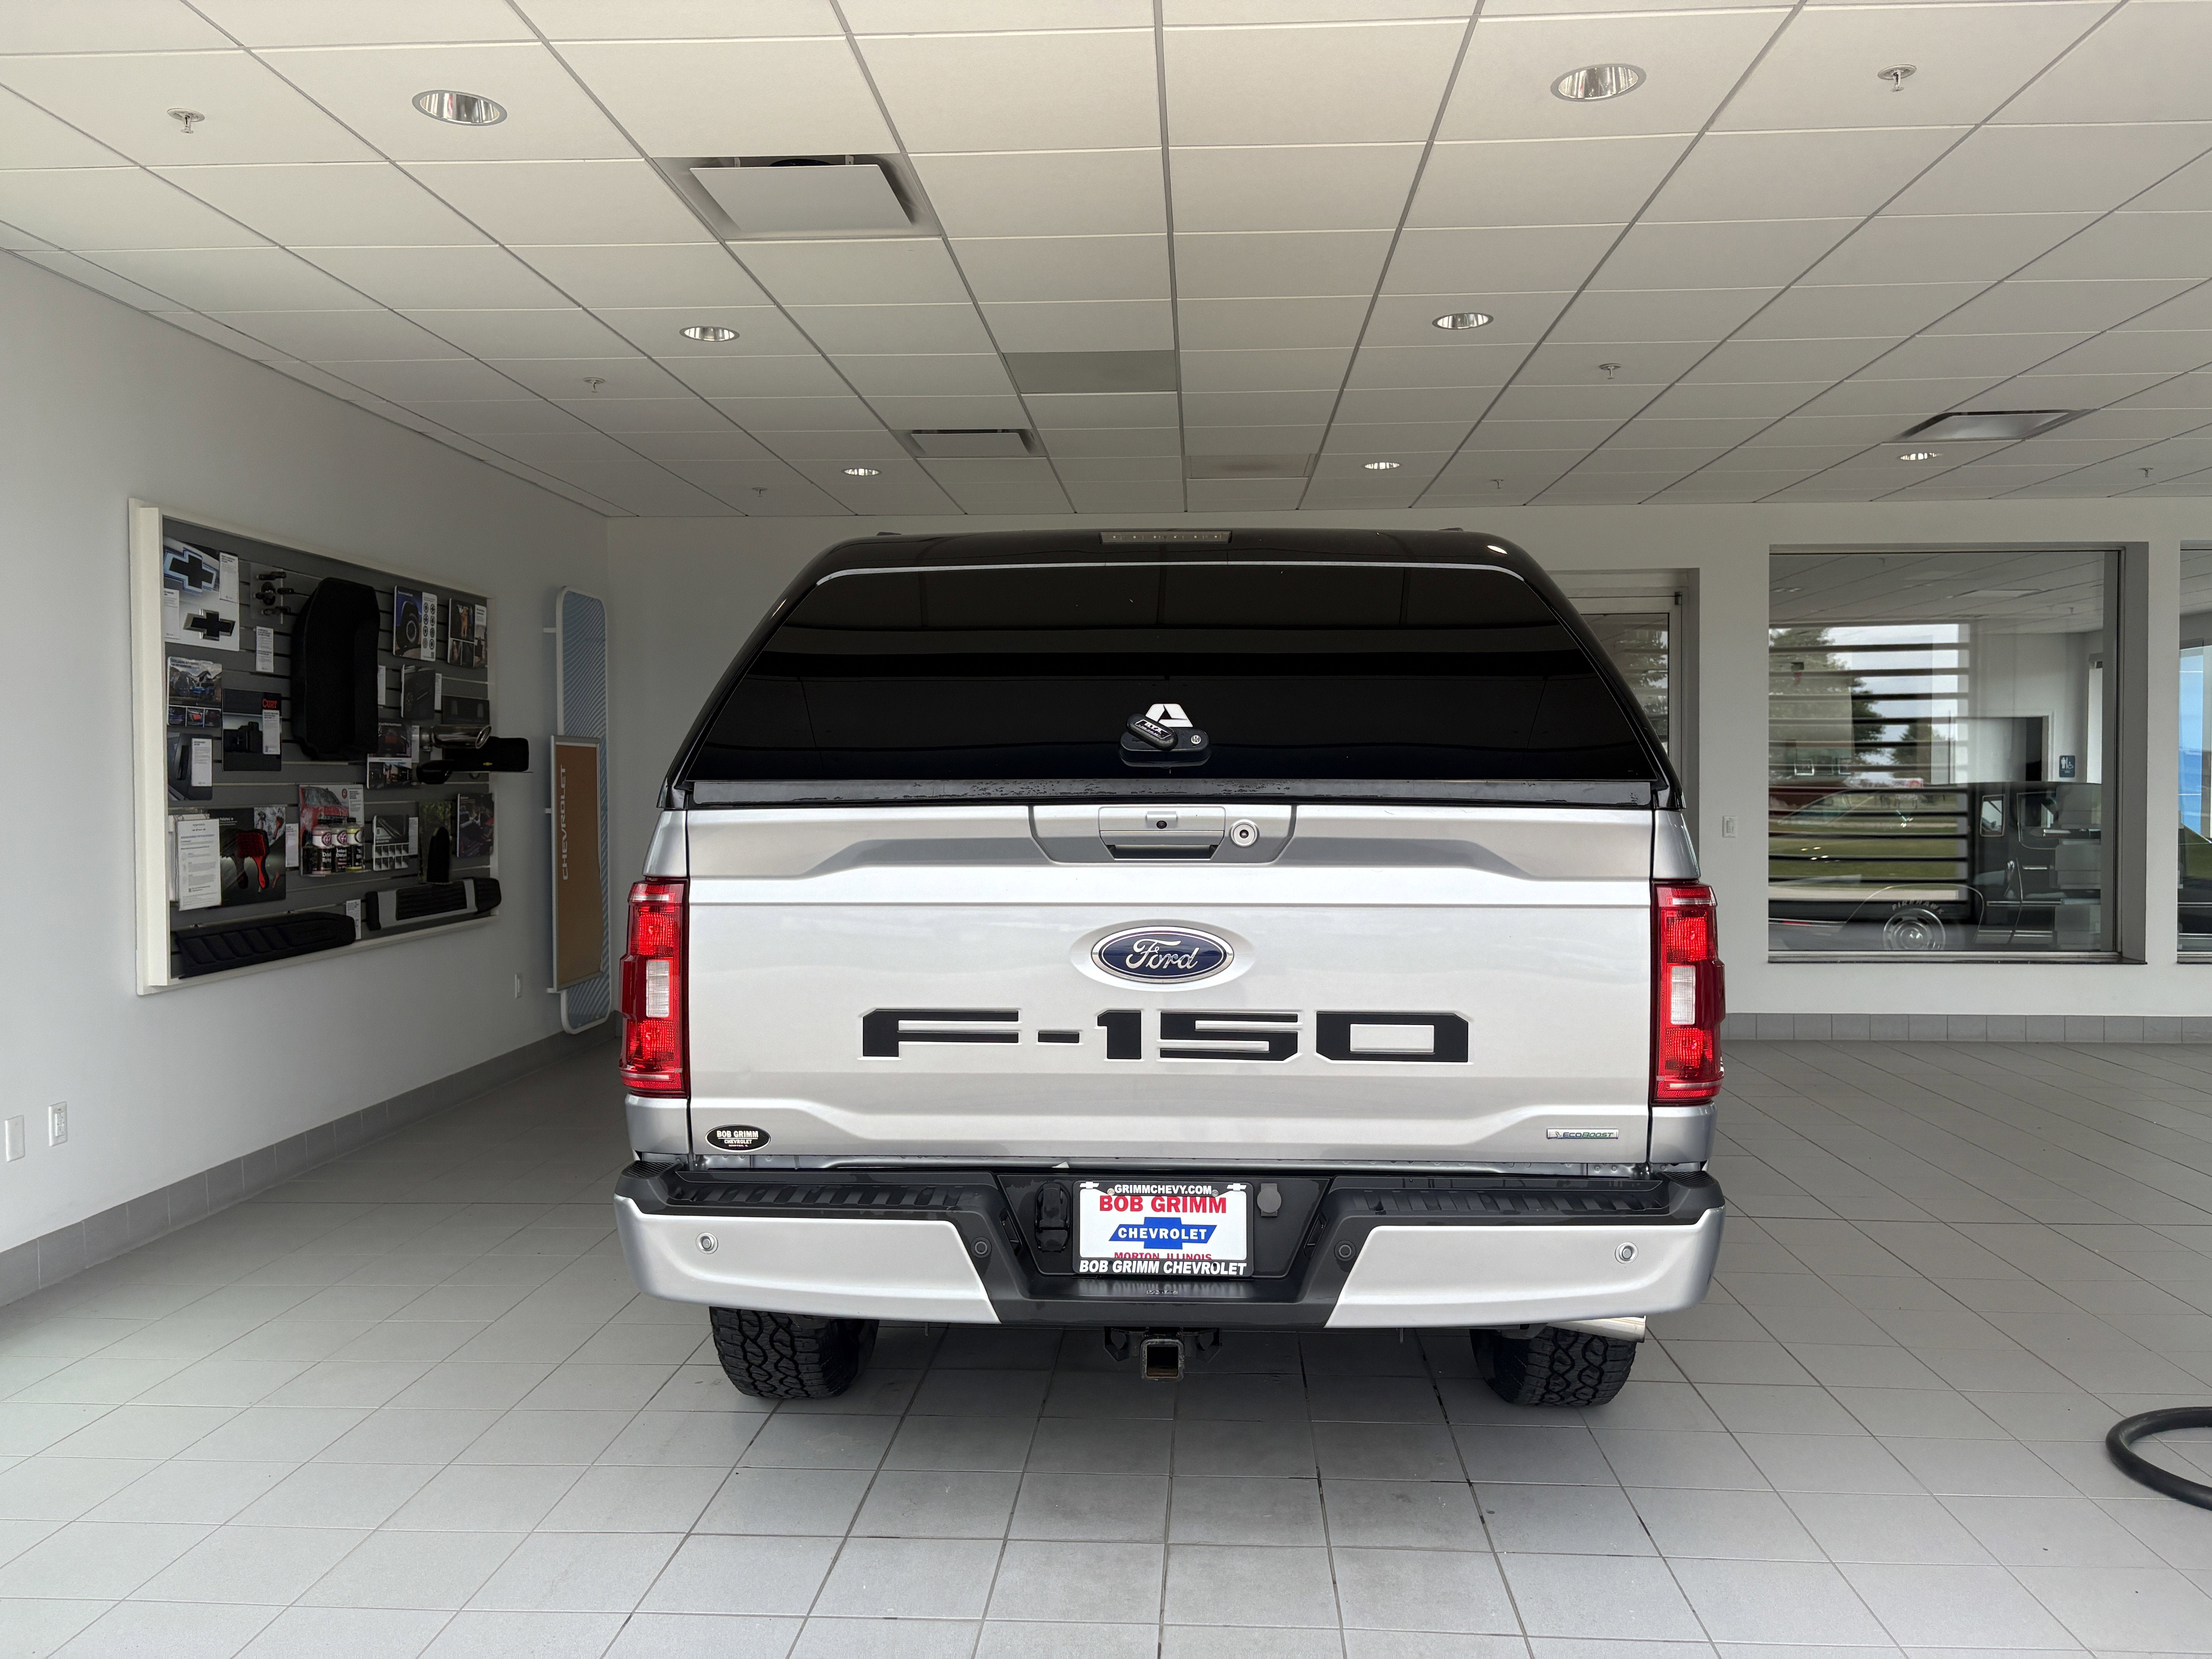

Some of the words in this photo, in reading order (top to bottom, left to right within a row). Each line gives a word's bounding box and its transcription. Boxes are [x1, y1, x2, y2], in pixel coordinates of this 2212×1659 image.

[1125, 938, 1200, 969] Ford
[863, 1008, 1468, 1062] F-150
[1114, 1184, 1212, 1194] GRIMMCHEVY.COM
[1100, 1195, 1143, 1211] BOB
[1151, 1196, 1226, 1213] GRIMM
[1118, 1227, 1207, 1240] CHEVROLET
[1079, 1260, 1108, 1273] BOB
[1112, 1261, 1159, 1273] GRIMM
[1163, 1261, 1247, 1275] CHEVROLET
